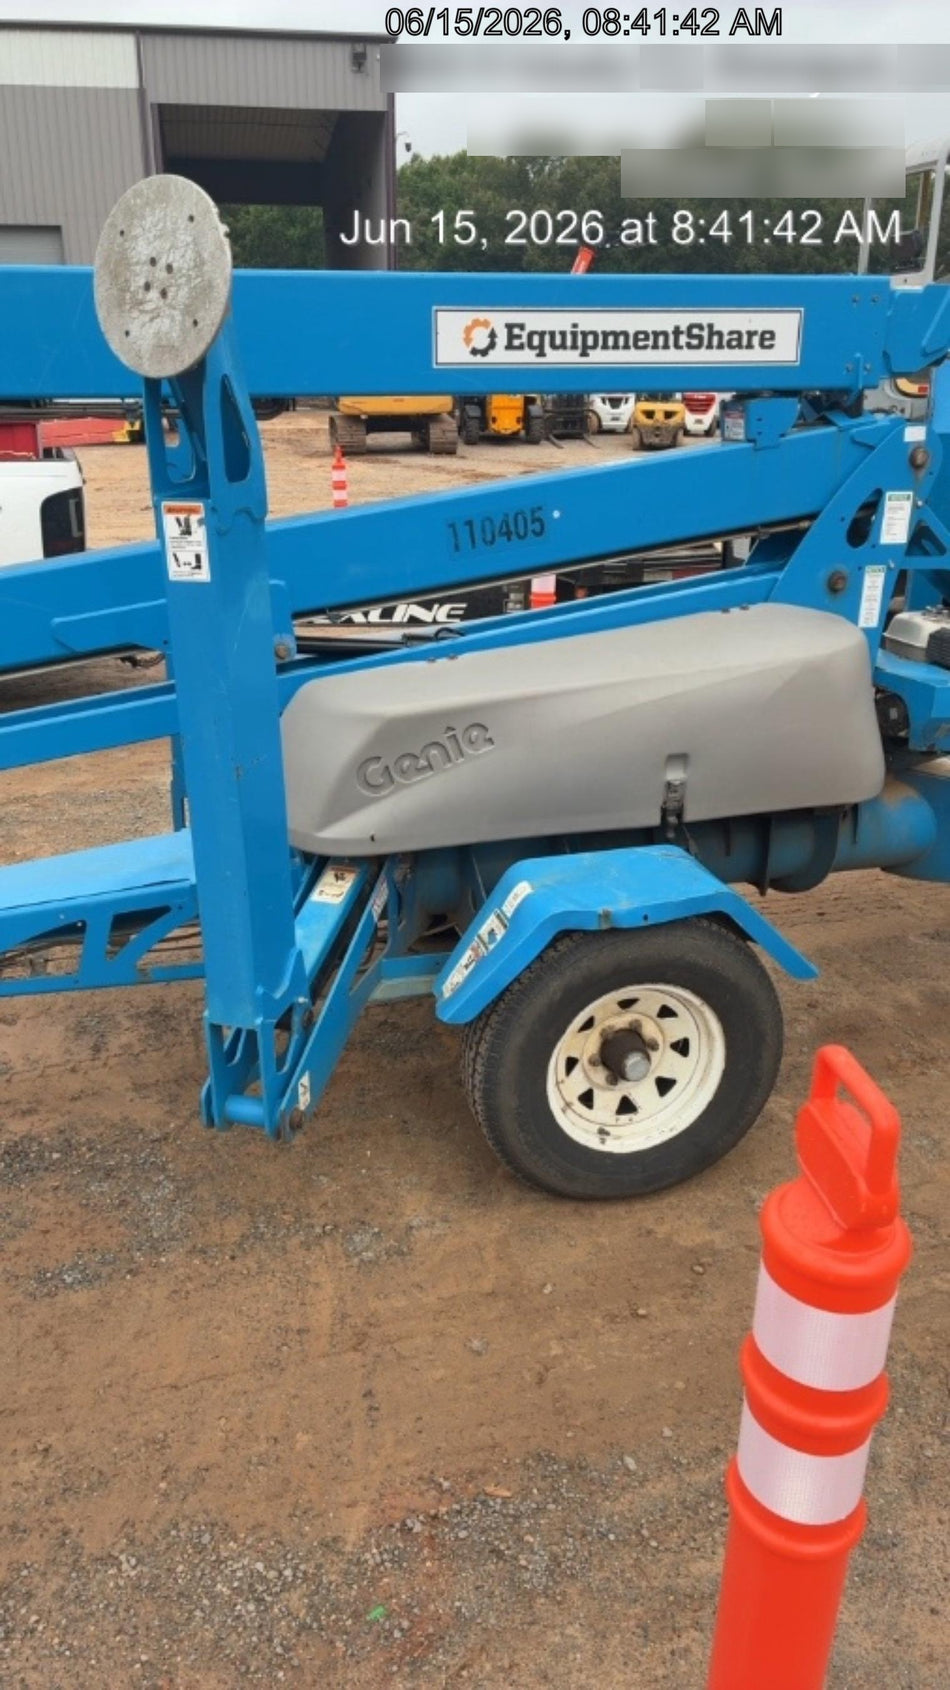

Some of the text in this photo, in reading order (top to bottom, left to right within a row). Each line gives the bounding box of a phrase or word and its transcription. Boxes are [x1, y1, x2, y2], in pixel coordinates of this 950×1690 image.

[504, 322, 776, 358] EquipmentShare
[447, 506, 545, 553] 110405
[356, 722, 495, 797] Genie
